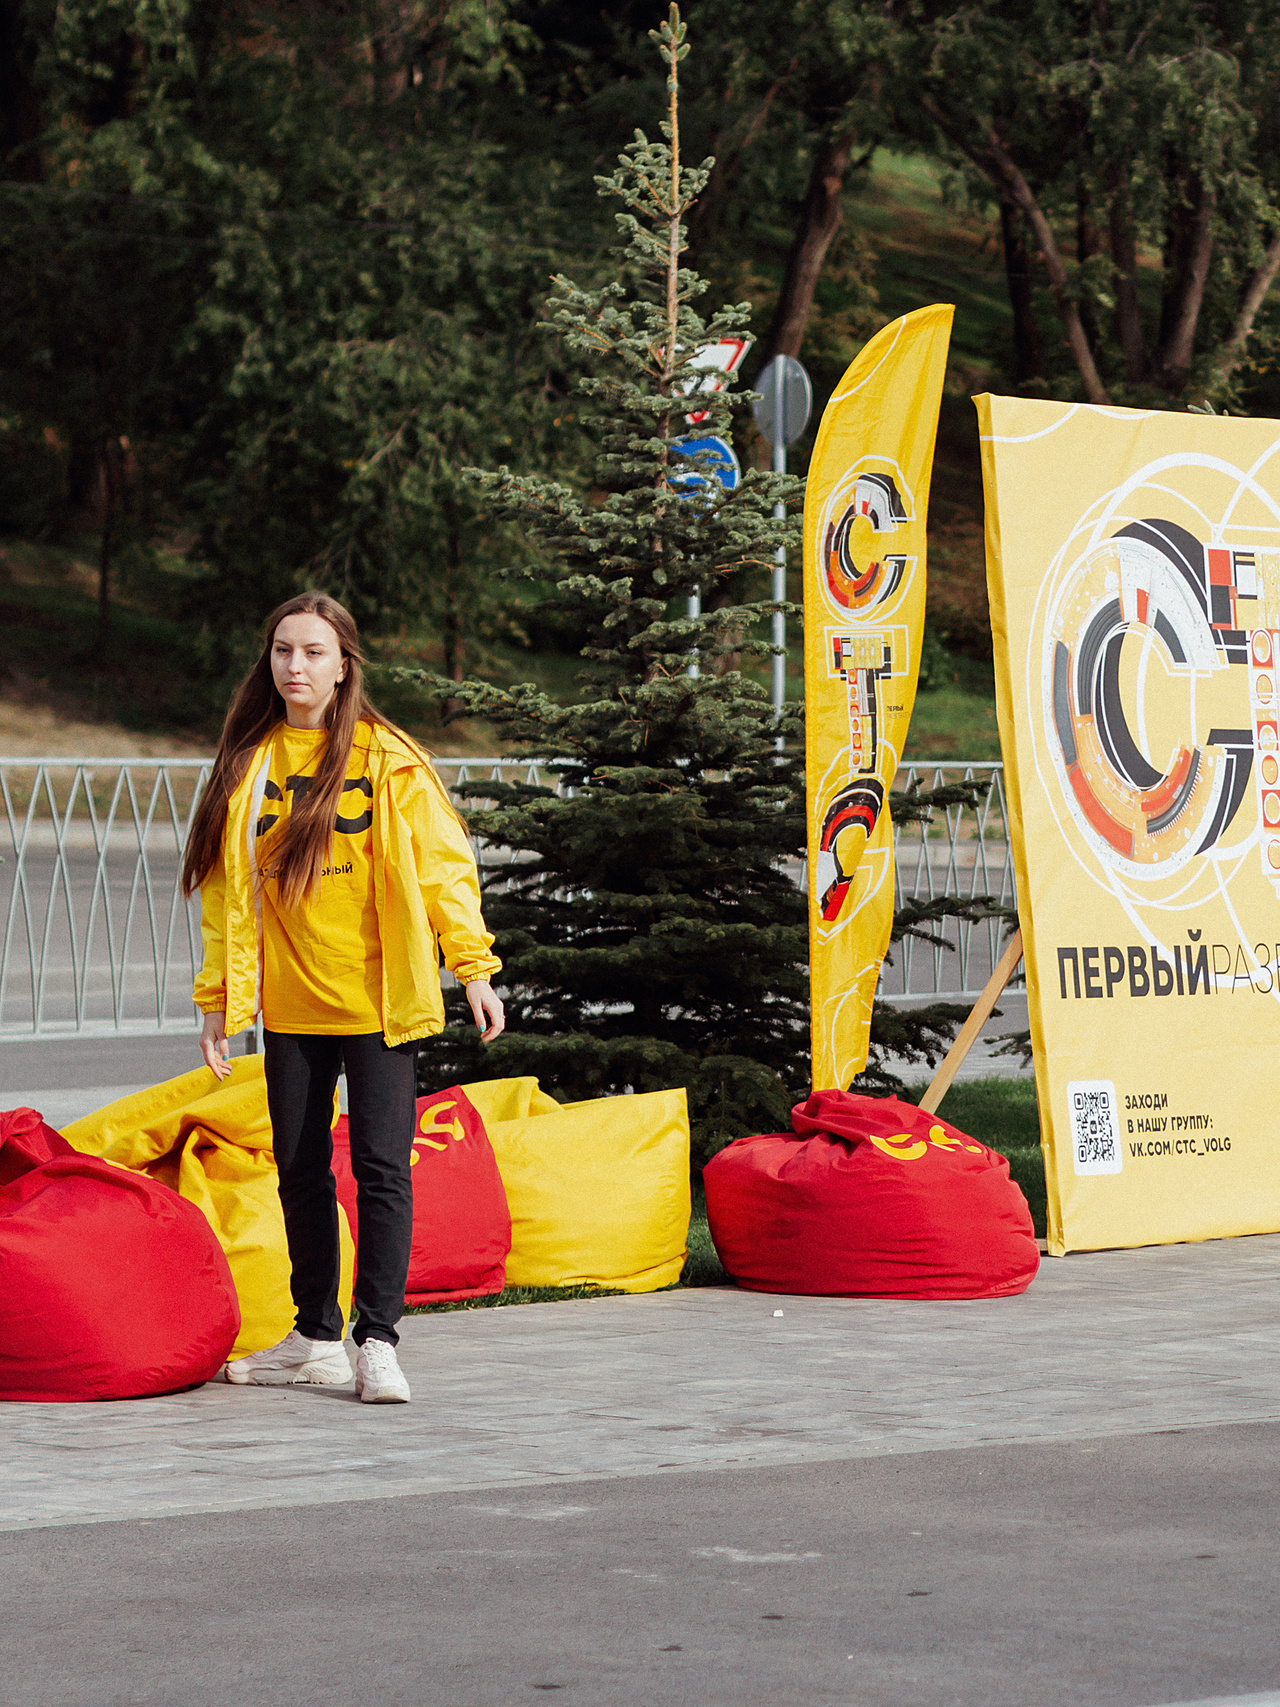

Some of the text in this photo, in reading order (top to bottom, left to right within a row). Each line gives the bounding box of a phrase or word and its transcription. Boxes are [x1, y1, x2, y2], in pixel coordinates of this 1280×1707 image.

[1125, 1093, 1168, 1110] ЗАХОДИ
[1127, 1115, 1213, 1133] В НАШУ ГРУППУ:
